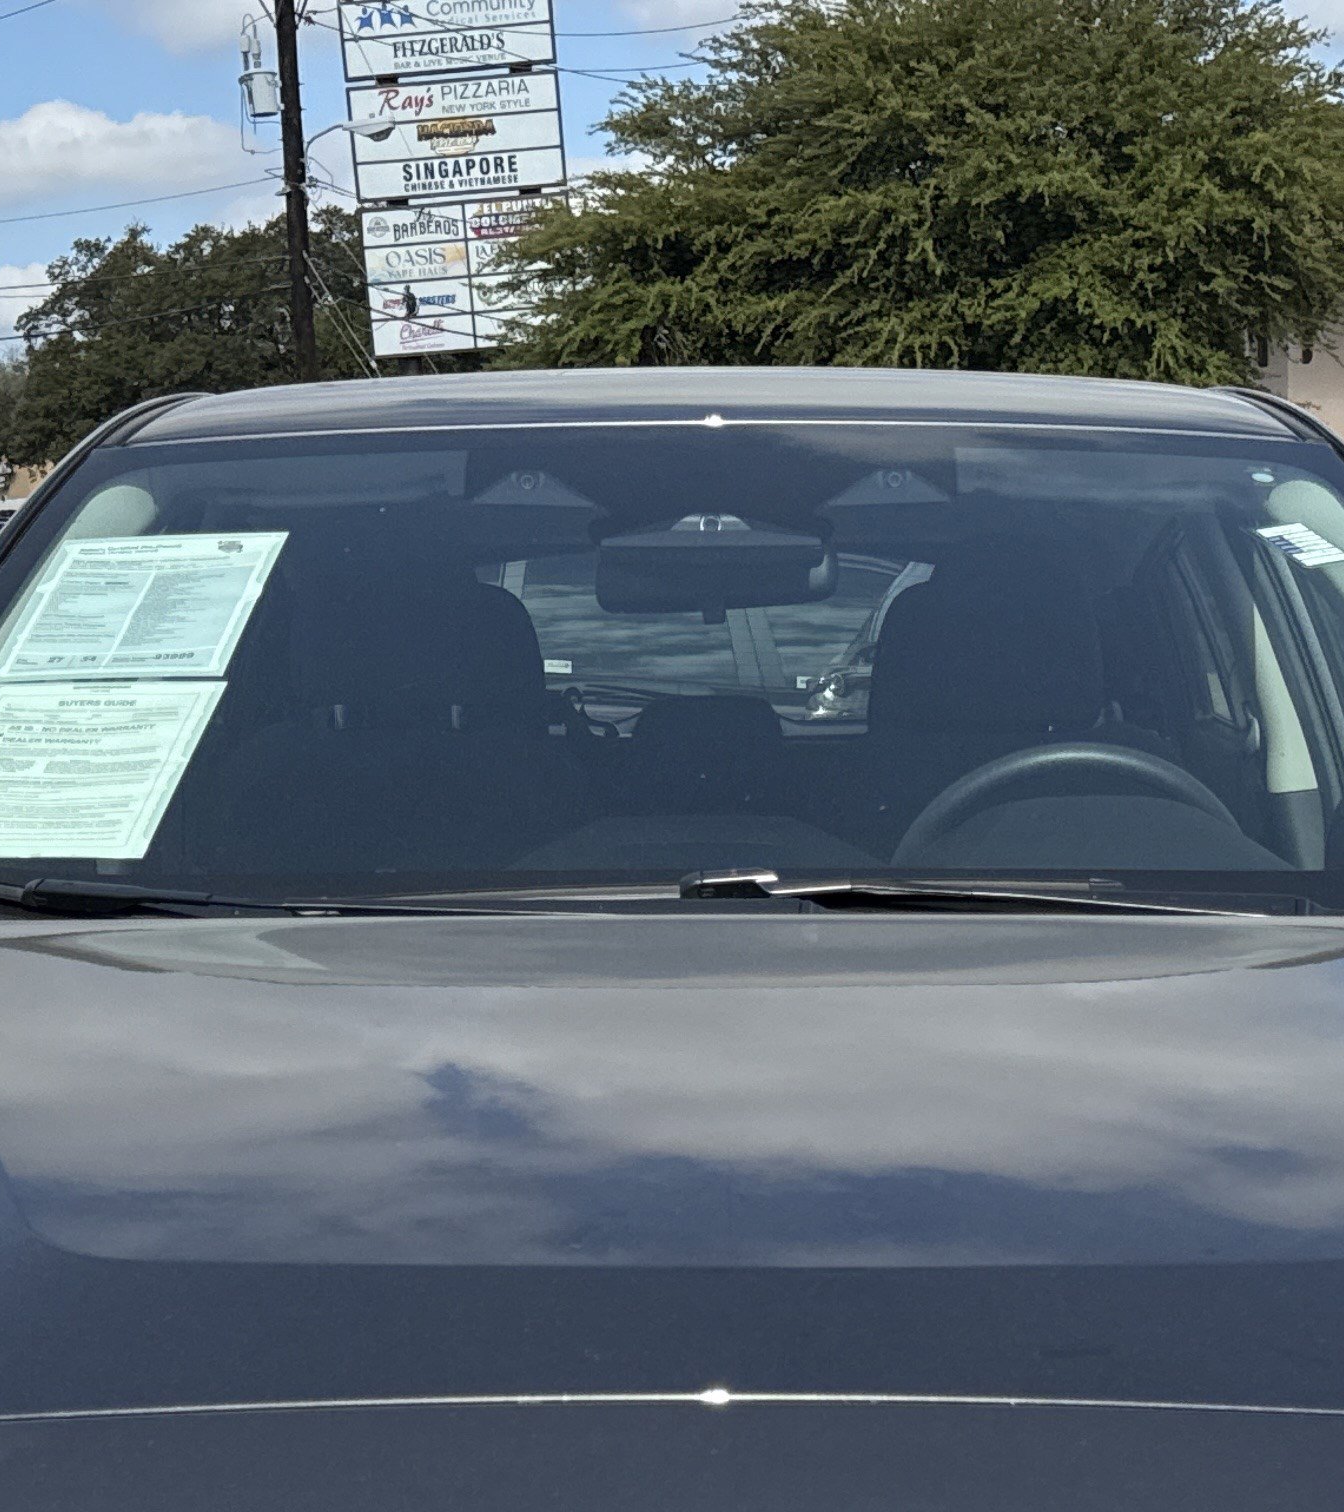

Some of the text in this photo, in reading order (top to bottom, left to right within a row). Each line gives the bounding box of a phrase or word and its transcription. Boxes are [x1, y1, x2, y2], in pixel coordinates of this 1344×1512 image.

[426, 0, 535, 16] Community
[393, 31, 505, 58] FITZGERALD'S
[378, 78, 530, 116] Ray's PIZZARIA
[442, 98, 531, 114] NEW YORK STYLE
[402, 155, 518, 182] SINGAPORE
[404, 174, 518, 192] CHINESE & VIETNAMESE
[393, 220, 459, 242] BARBEROS
[386, 247, 446, 268] OASIS
[58, 699, 138, 707] BUYERS GUIDE
